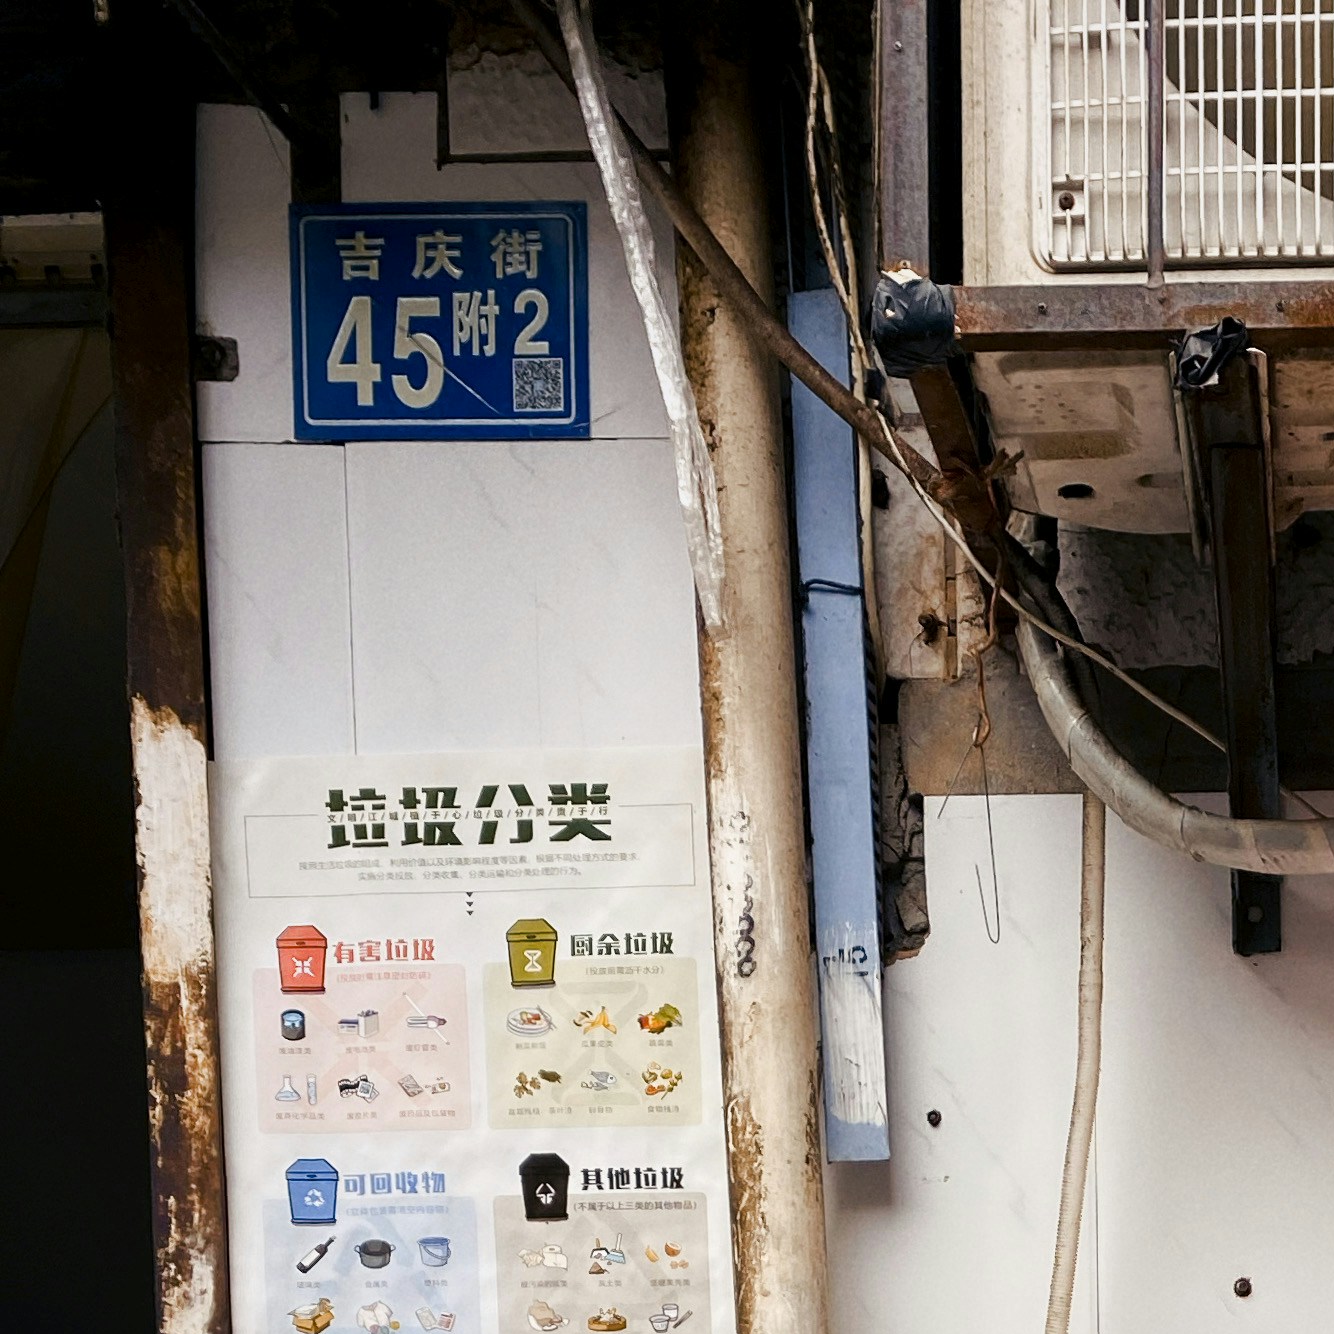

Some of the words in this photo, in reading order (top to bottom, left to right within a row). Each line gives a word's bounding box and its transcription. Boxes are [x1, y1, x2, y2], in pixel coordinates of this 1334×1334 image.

[335, 229, 542, 280] 吉庆街
[325, 783, 612, 849] 垃圾分类
[333, 938, 436, 964] 有害垃圾
[570, 932, 675, 957] 厨余垃圾
[343, 1171, 445, 1196] 可回收物
[581, 1167, 685, 1191] 其他垃圾
